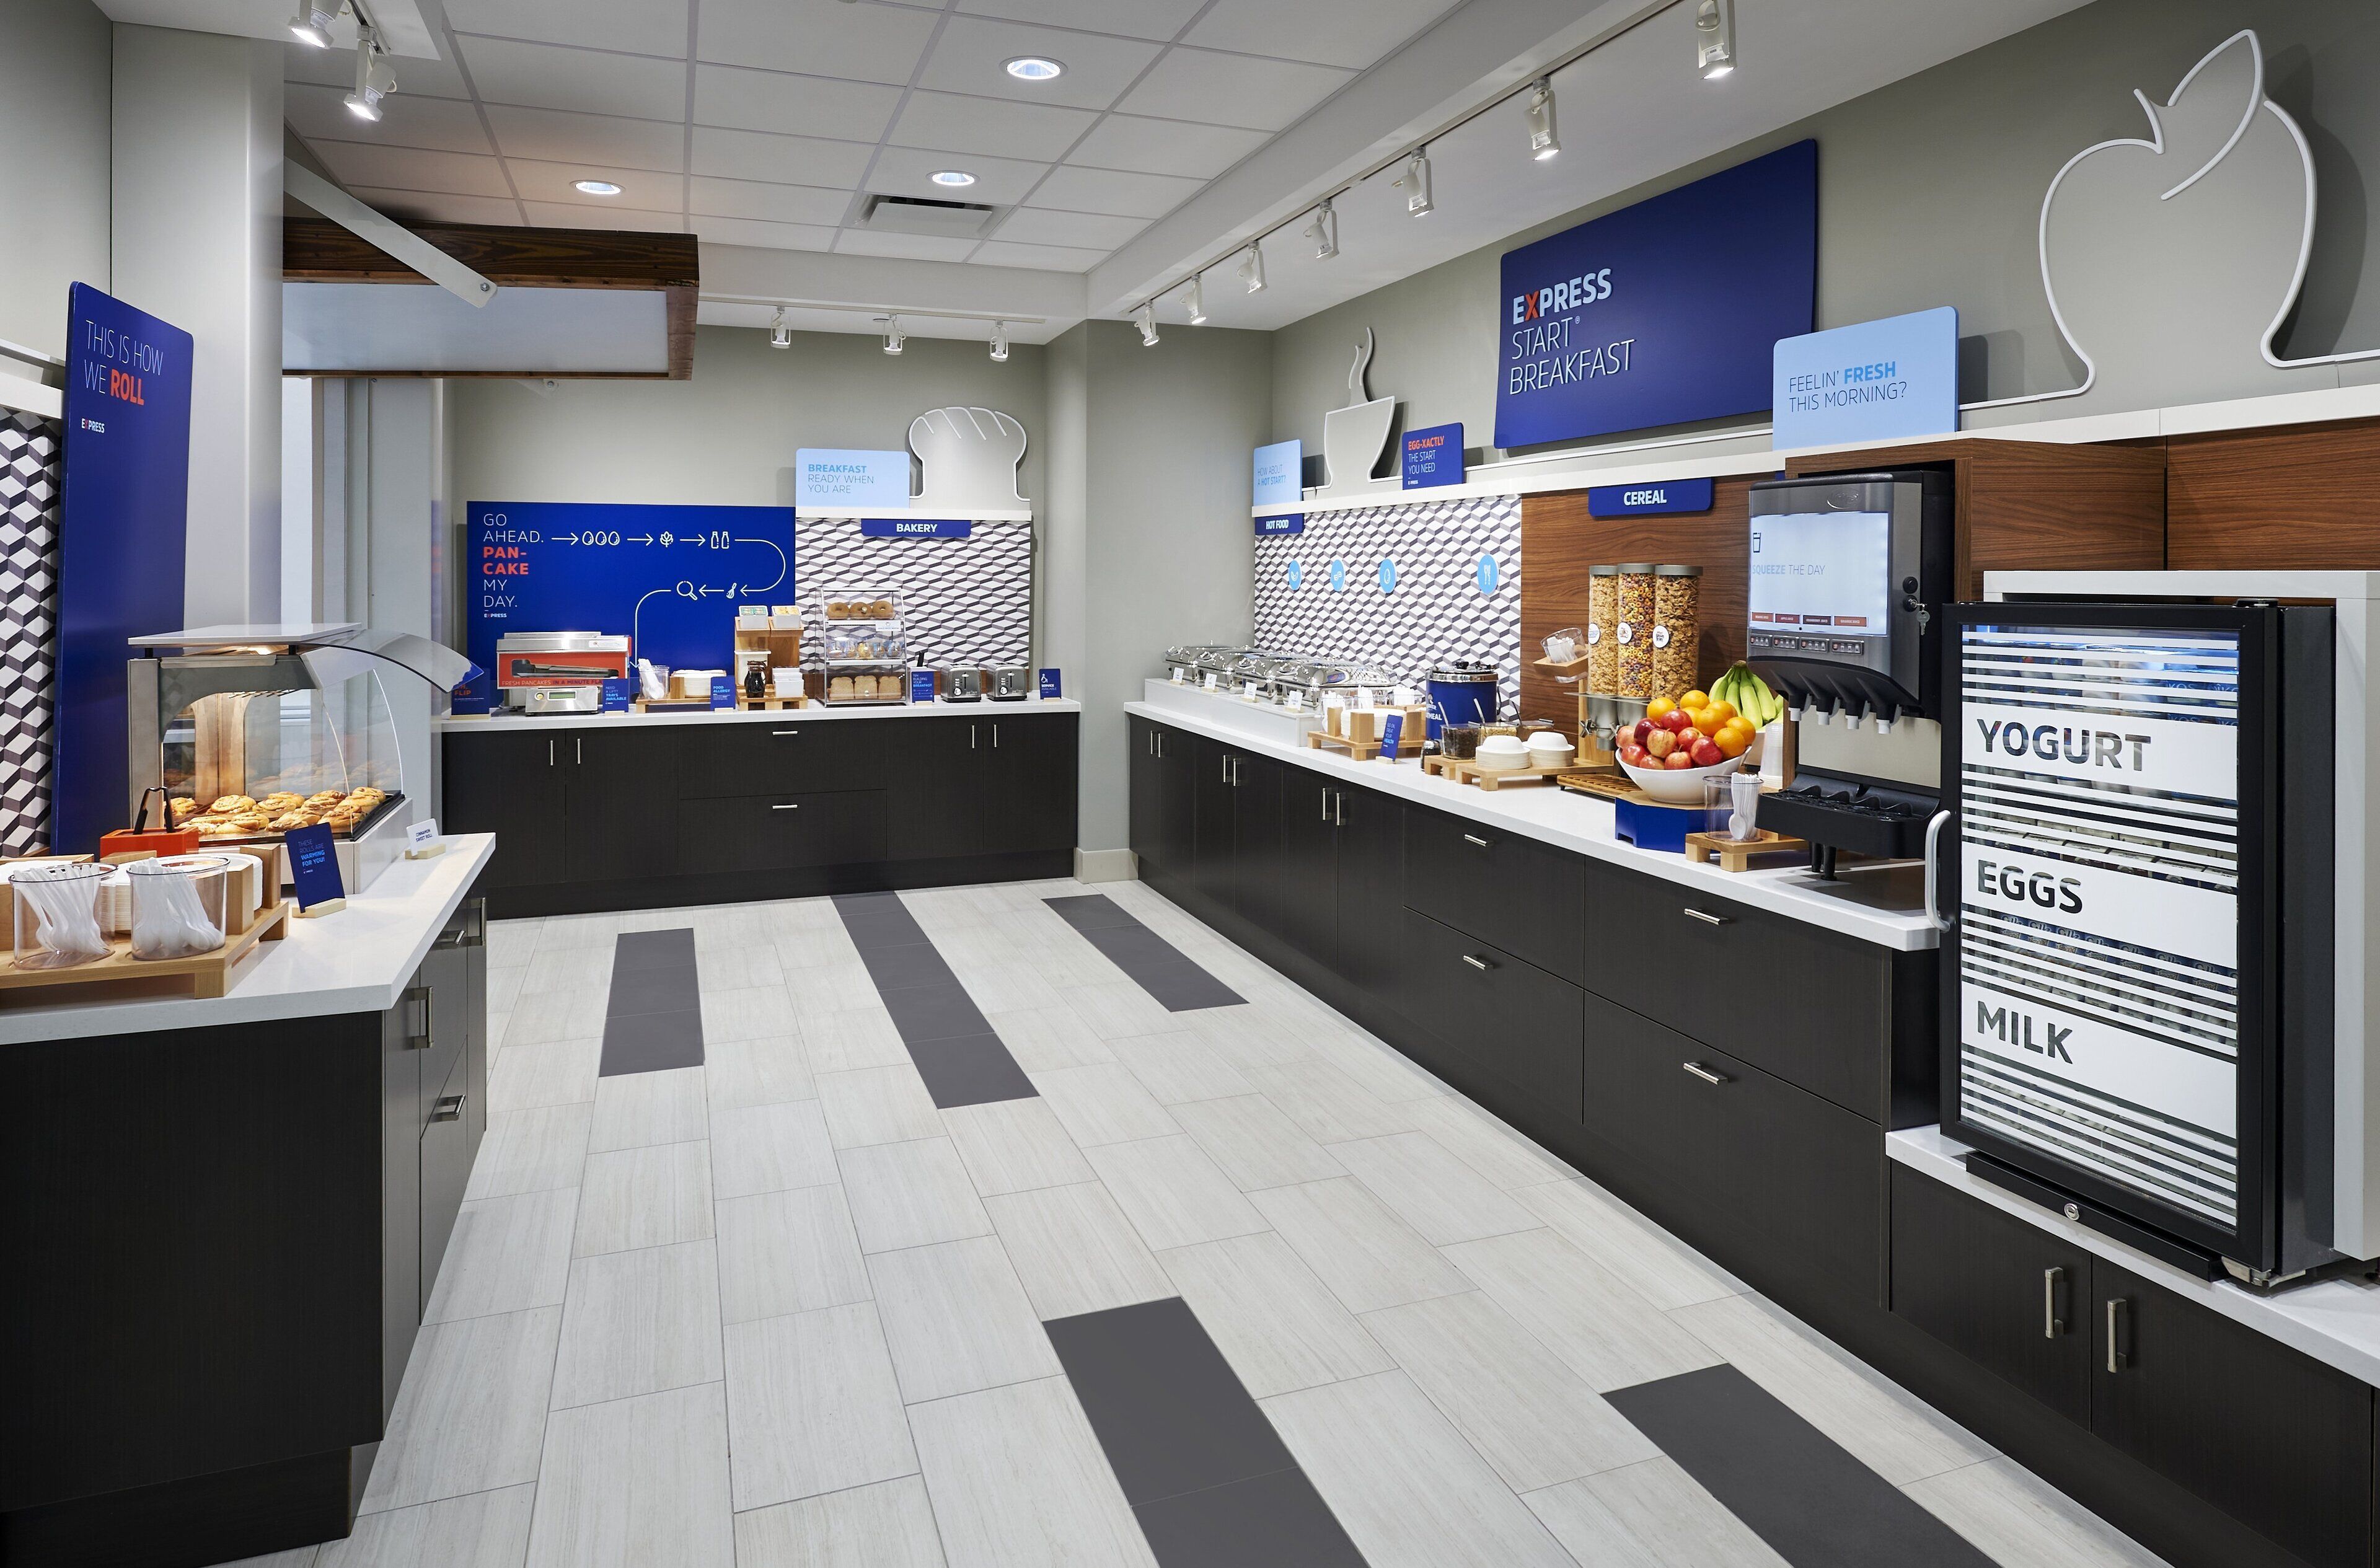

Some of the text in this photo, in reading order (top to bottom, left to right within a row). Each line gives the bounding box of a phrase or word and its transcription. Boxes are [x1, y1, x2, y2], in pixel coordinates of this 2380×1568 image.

[1513, 268, 1613, 325] EXPRESS
[86, 319, 164, 376] THIS IS HOW
[1510, 338, 1635, 395] BREAKFAST
[1844, 361, 1896, 385] FRESH
[84, 359, 145, 406] WE ROLL
[1789, 381, 1907, 413] THIS MORNING?
[81, 418, 105, 433] EXPRESS
[1408, 435, 1445, 451] EGG-XACTLY
[1408, 449, 1436, 463] THE START
[808, 464, 867, 473] BREAKFAST
[1258, 464, 1283, 477] HOW ABOUT
[1408, 462, 1435, 475] YOU NEED
[808, 474, 875, 484] READY WHEN
[1258, 475, 1286, 487] A HOT START?
[808, 485, 851, 494] YOU ARE
[1623, 489, 1667, 506] CEREAL
[483, 513, 508, 527] GO
[1266, 519, 1289, 530] HOT FOOD
[896, 523, 938, 534] BAKERY
[483, 531, 544, 544] AHEAD.
[483, 547, 527, 559] PAN-
[483, 563, 529, 575] CAKE
[1752, 565, 1825, 575] SQUEEZE THE DAY
[483, 579, 508, 591] MY
[483, 596, 518, 608] DAY.
[1977, 718, 2151, 772] YOGURT
[1978, 859, 2083, 915] EGGS
[1977, 1000, 2073, 1065] MILK
